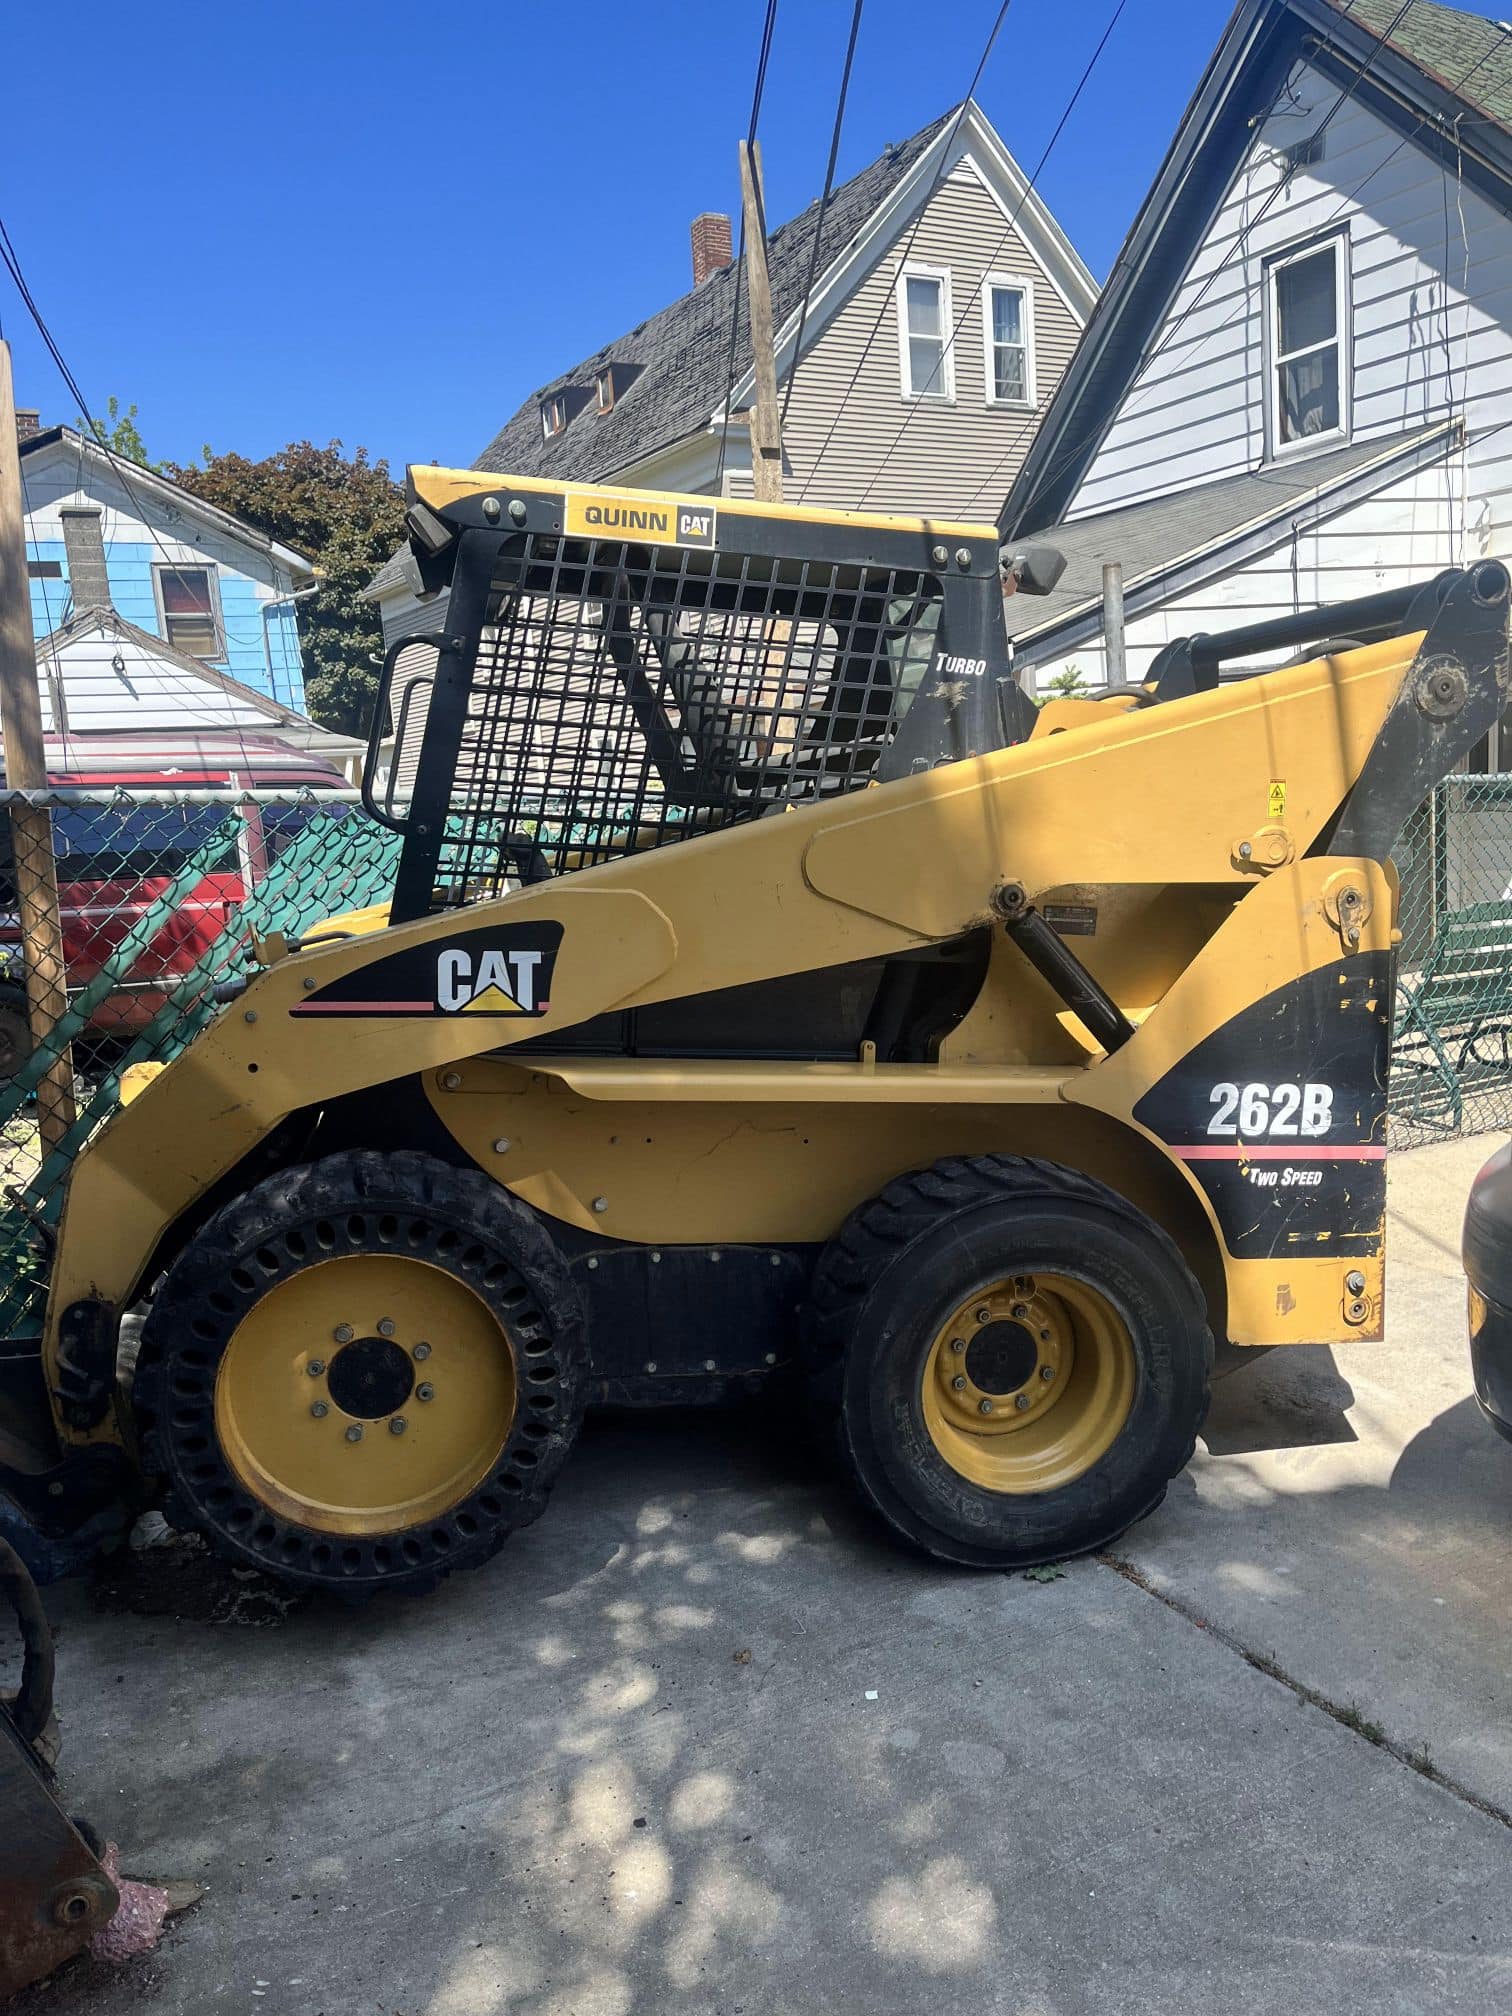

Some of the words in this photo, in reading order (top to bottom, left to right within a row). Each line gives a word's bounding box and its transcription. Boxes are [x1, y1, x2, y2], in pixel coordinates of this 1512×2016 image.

[585, 506, 668, 531] QUINN
[680, 515, 711, 536] CAT
[936, 652, 987, 676] TURBO
[437, 949, 542, 1011] CAT
[1206, 1082, 1334, 1136] 262B
[1250, 1168, 1278, 1186] TWO
[1281, 1167, 1323, 1186] SPEED
